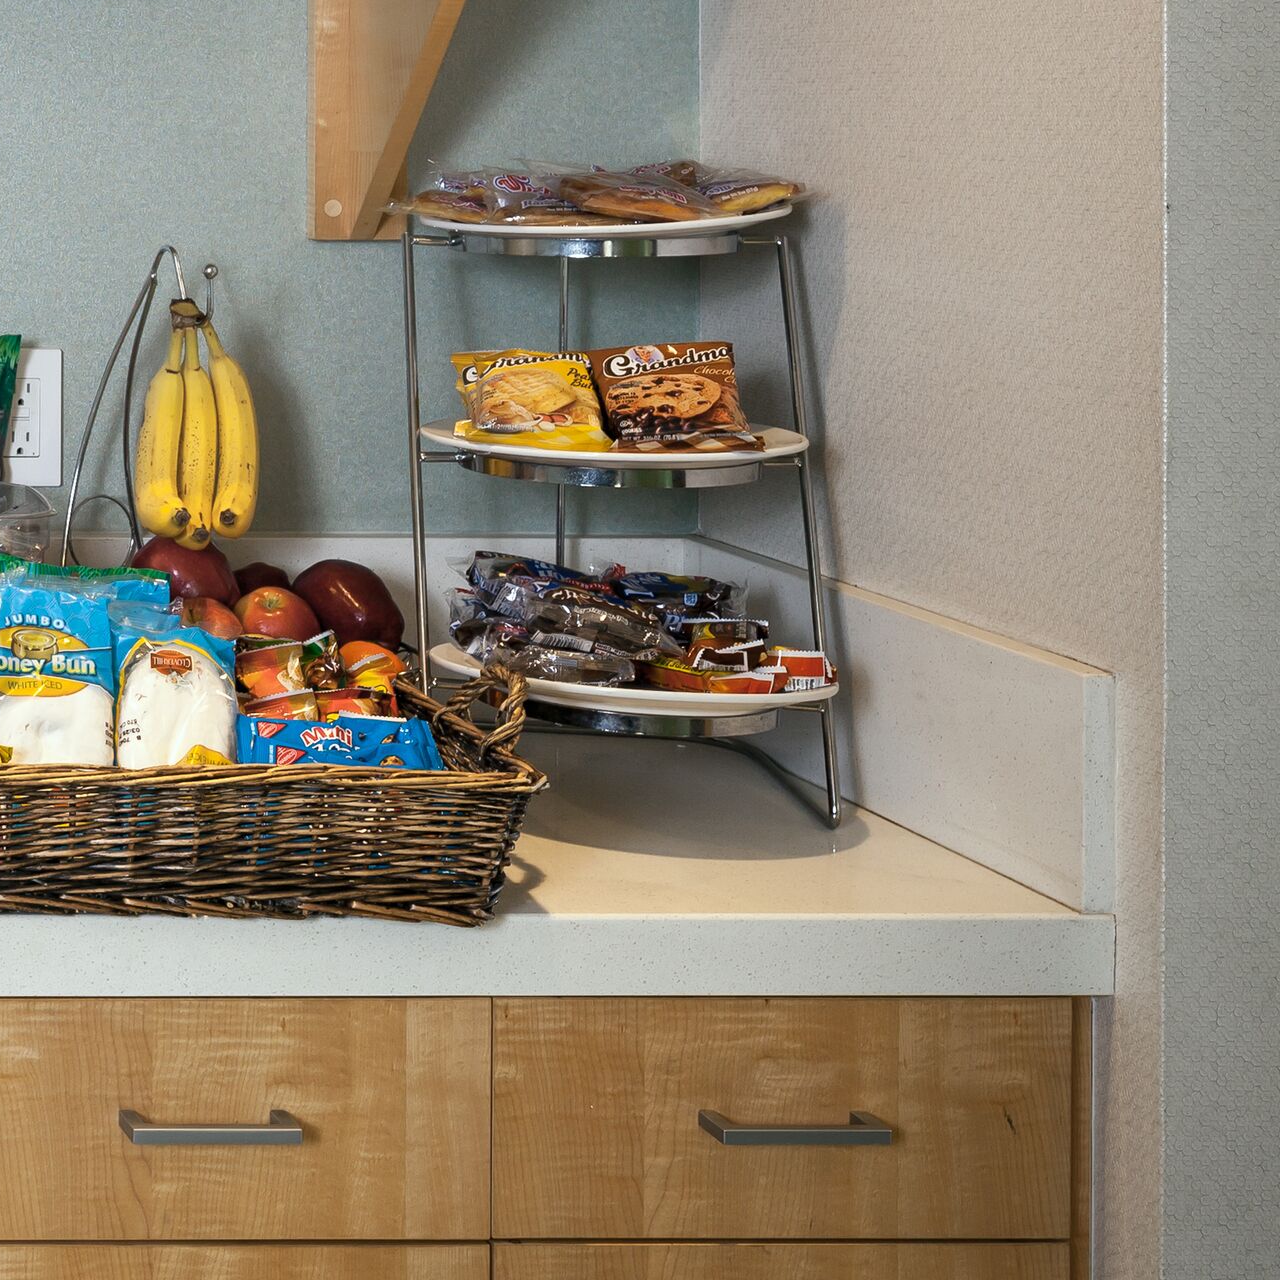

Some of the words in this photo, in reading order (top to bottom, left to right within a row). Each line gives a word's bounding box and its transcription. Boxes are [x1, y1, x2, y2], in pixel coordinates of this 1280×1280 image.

[4, 613, 67, 631] JUMBO
[51, 653, 96, 676] Bun
[7, 680, 41, 690] WHITE
[40, 680, 63, 690] ICED
